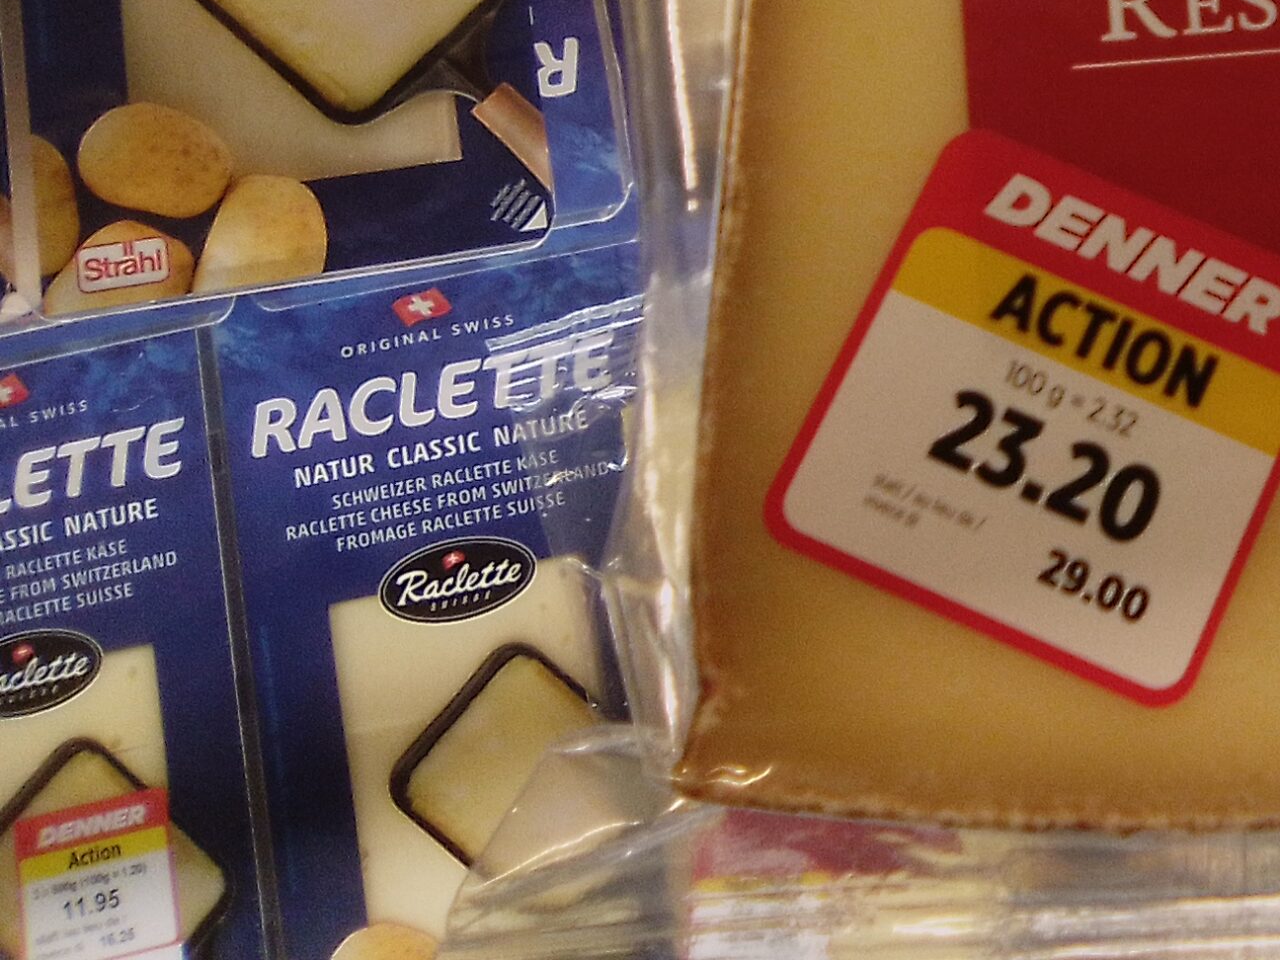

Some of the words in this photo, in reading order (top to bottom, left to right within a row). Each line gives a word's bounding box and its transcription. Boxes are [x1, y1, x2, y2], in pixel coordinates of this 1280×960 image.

[340, 328, 441, 359] ORIGINAL
[451, 314, 515, 337] SWISS
[989, 273, 1220, 410] ACTION
[29, 399, 88, 424] SWISS
[250, 330, 615, 459] RACLETTE
[1003, 359, 1044, 398] 100
[1048, 382, 1066, 409] g
[1086, 396, 1139, 440] 2.32
[0, 416, 186, 515] ETTE
[294, 454, 376, 490] NATUR
[387, 435, 482, 468] CLASSIC
[494, 409, 590, 450] NATURE
[926, 388, 1163, 544] 23.20
[331, 480, 429, 511] SCHWEIZER
[432, 461, 512, 491] RACLETTE
[63, 498, 160, 538] NATURE
[285, 510, 368, 542] RACLETTE
[370, 497, 434, 524] CHEESE
[437, 486, 490, 511] FROM
[335, 524, 418, 553] FROMAGE
[421, 507, 503, 538] RACLETTE
[507, 491, 567, 518] SUISSE
[5, 548, 82, 579] RACLETTE
[10, 577, 57, 601] FROM
[61, 550, 178, 590] SWITZERLAND
[396, 560, 523, 608] Raclette
[1036, 549, 1152, 624] 29.00
[76, 582, 134, 609] SUISSE
[0, 651, 90, 691] clette
[37, 803, 147, 850] DENNER
[67, 842, 122, 874] Action
[60, 889, 122, 922] 11.95
